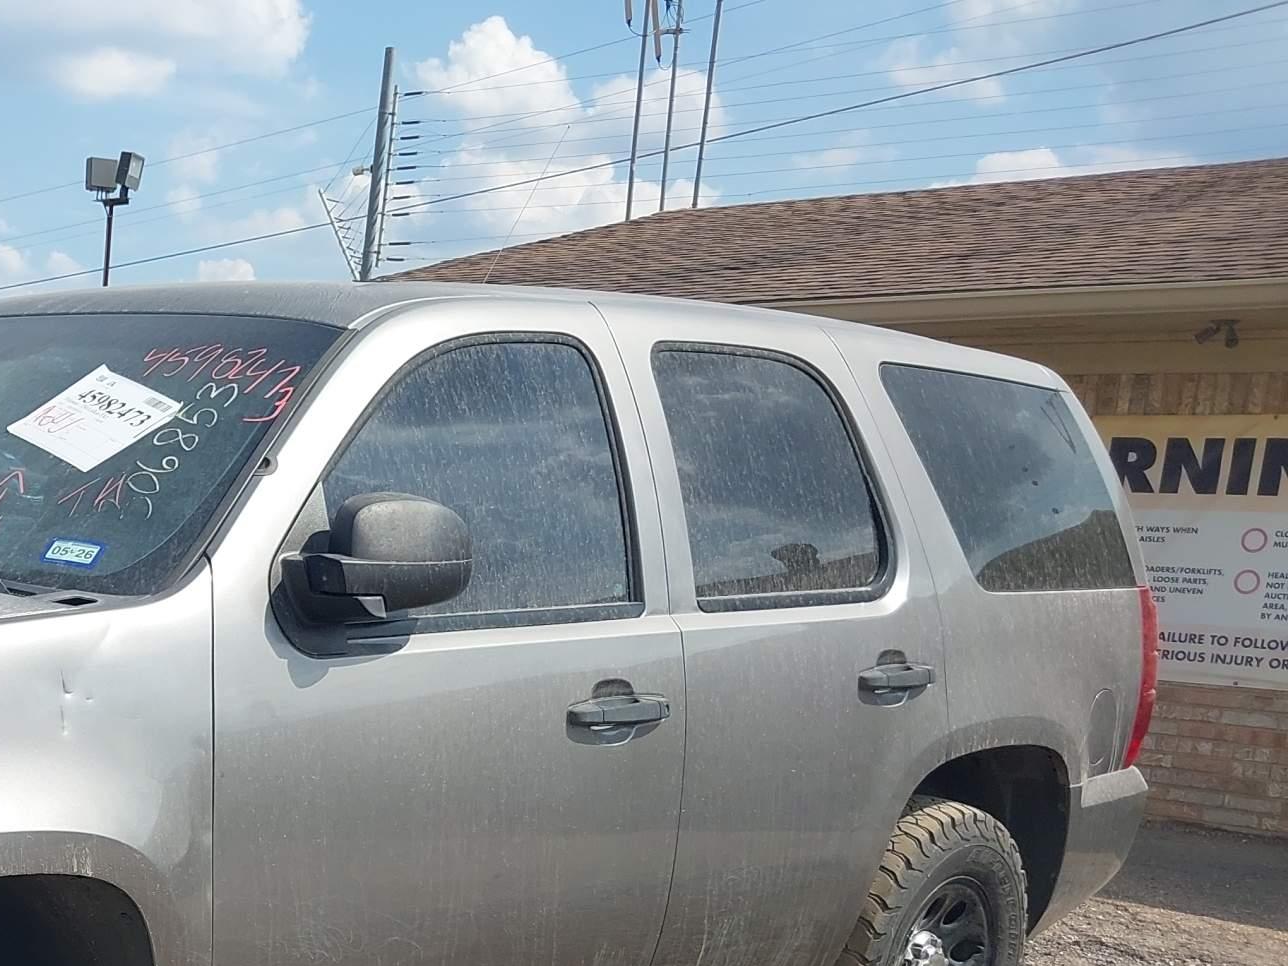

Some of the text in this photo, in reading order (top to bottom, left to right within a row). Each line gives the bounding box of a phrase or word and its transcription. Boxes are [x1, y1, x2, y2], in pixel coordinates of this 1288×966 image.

[78, 389, 151, 427] 45982473
[1139, 535, 1165, 543] AISLES
[1152, 575, 1179, 583] LOOSE
[1266, 582, 1285, 590] NOT
[1169, 587, 1203, 595] UNEVEN
[1260, 612, 1272, 620] BY
[1210, 634, 1228, 647] TO
[1210, 653, 1264, 668] INJURY
